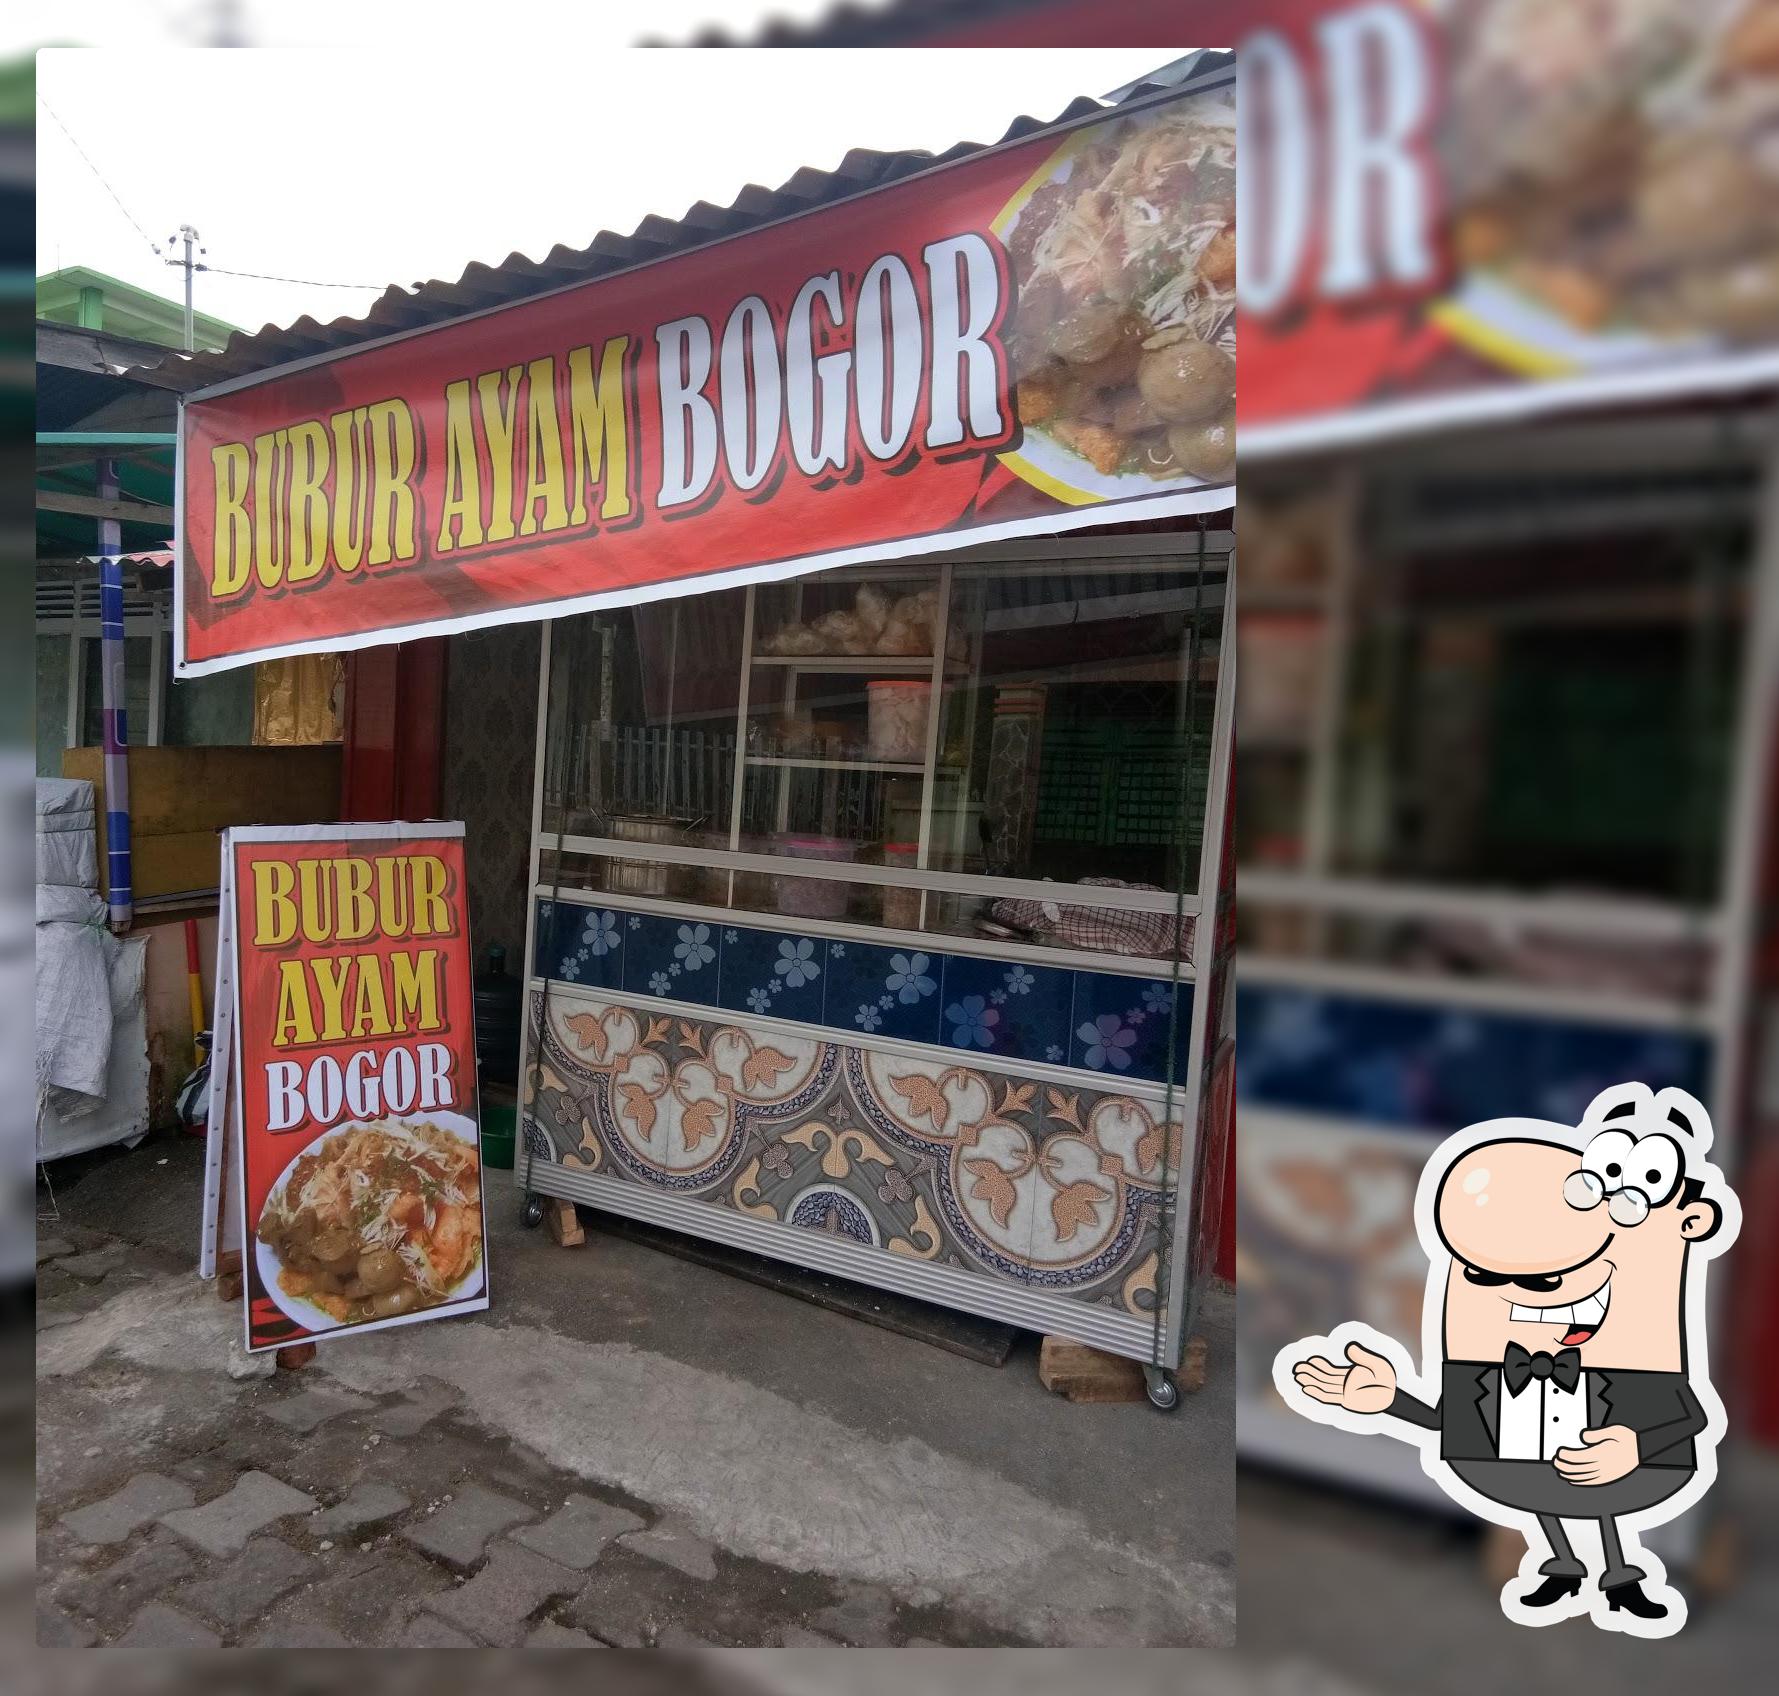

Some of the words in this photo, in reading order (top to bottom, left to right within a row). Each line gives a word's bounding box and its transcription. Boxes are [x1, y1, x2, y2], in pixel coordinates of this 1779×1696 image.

[211, 397, 416, 598] BUBUR
[437, 335, 631, 552] AYAM
[655, 232, 1003, 508] BOGOR
[251, 855, 451, 946] BUBUR
[273, 949, 441, 1047] AYAM
[264, 1042, 453, 1132] BOGOR
